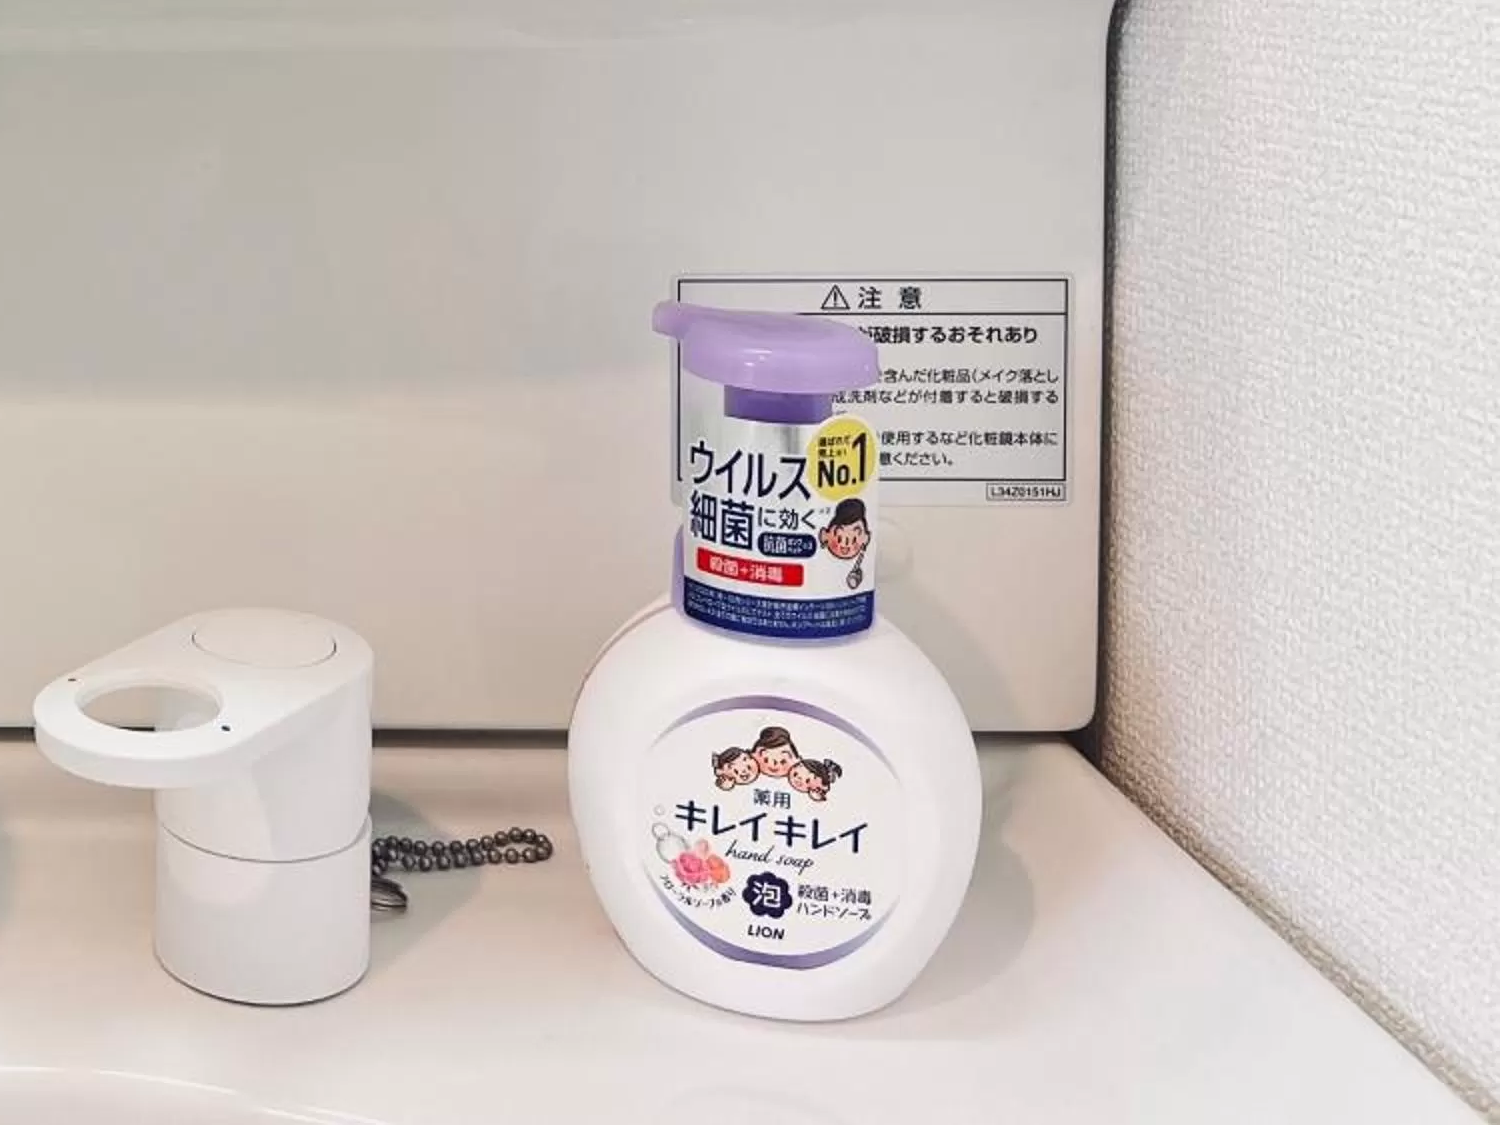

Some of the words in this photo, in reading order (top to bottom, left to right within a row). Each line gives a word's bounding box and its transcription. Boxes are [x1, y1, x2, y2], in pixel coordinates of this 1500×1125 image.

[690, 440, 811, 501] ウイルス
[817, 432, 867, 489] No.1
[753, 788, 792, 810] 薬用
[675, 800, 869, 855] キレイキレイ
[724, 838, 775, 865] hand
[775, 852, 816, 876] soap
[751, 879, 783, 909] 泡
[796, 901, 873, 922] ハンドソープ
[747, 923, 786, 940] LION
